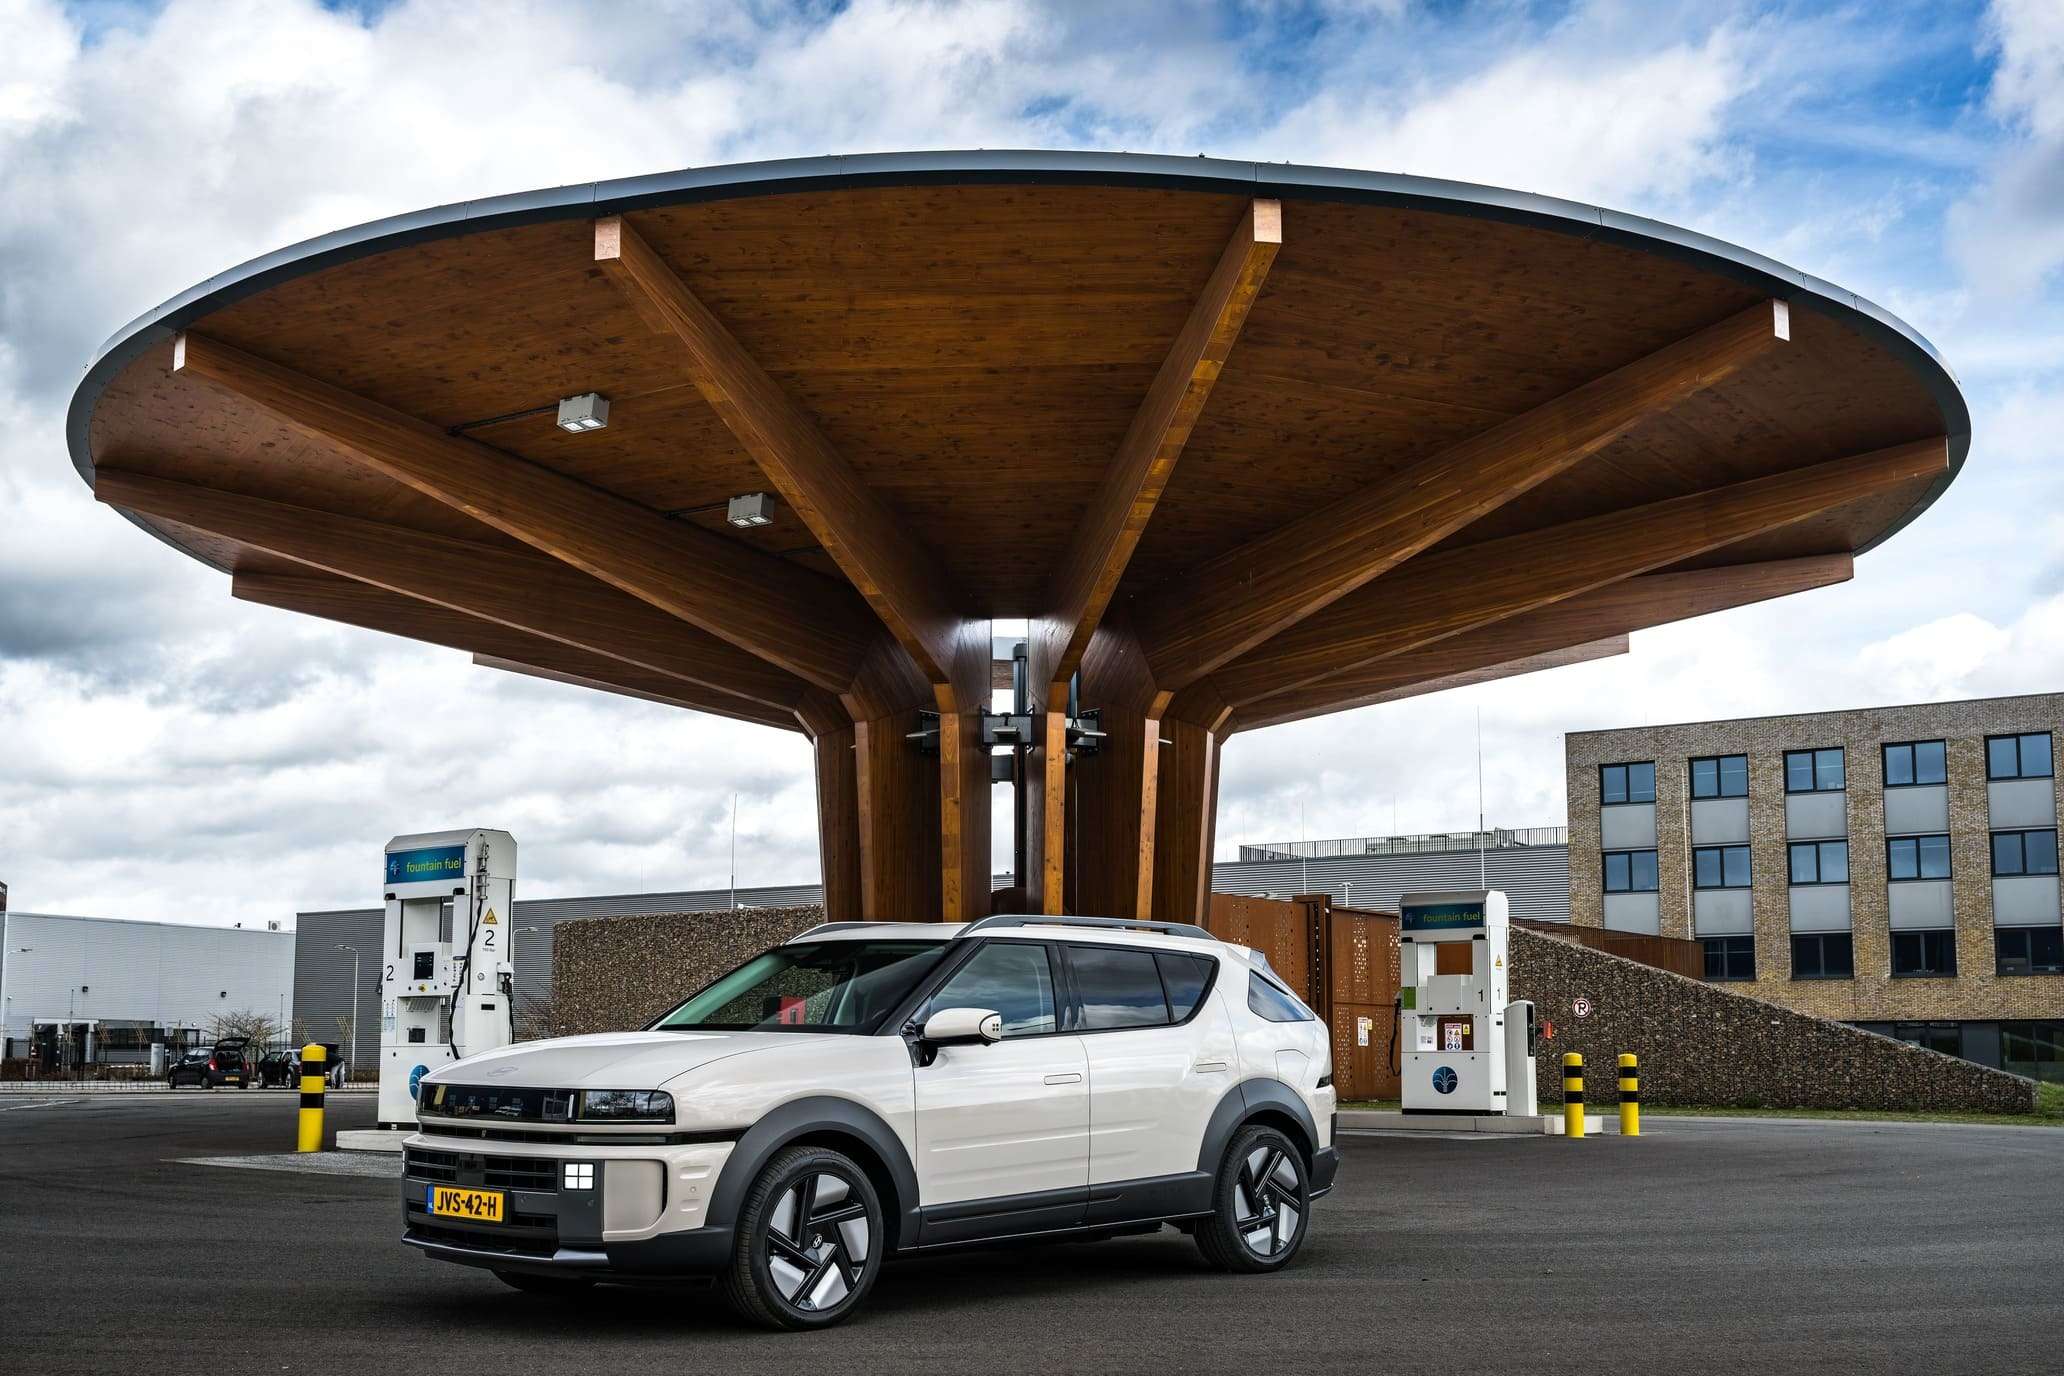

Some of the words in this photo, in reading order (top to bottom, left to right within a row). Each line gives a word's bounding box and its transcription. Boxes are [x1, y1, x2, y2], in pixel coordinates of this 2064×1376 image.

[407, 859, 442, 873] fountain
[445, 857, 461, 869] fuel
[1424, 912, 1460, 923] fountain
[1463, 911, 1480, 921] fuel
[485, 929, 495, 946] 2
[386, 964, 394, 981] 2
[1478, 989, 1483, 1002] 1
[437, 1191, 496, 1217] JVS-42-H
